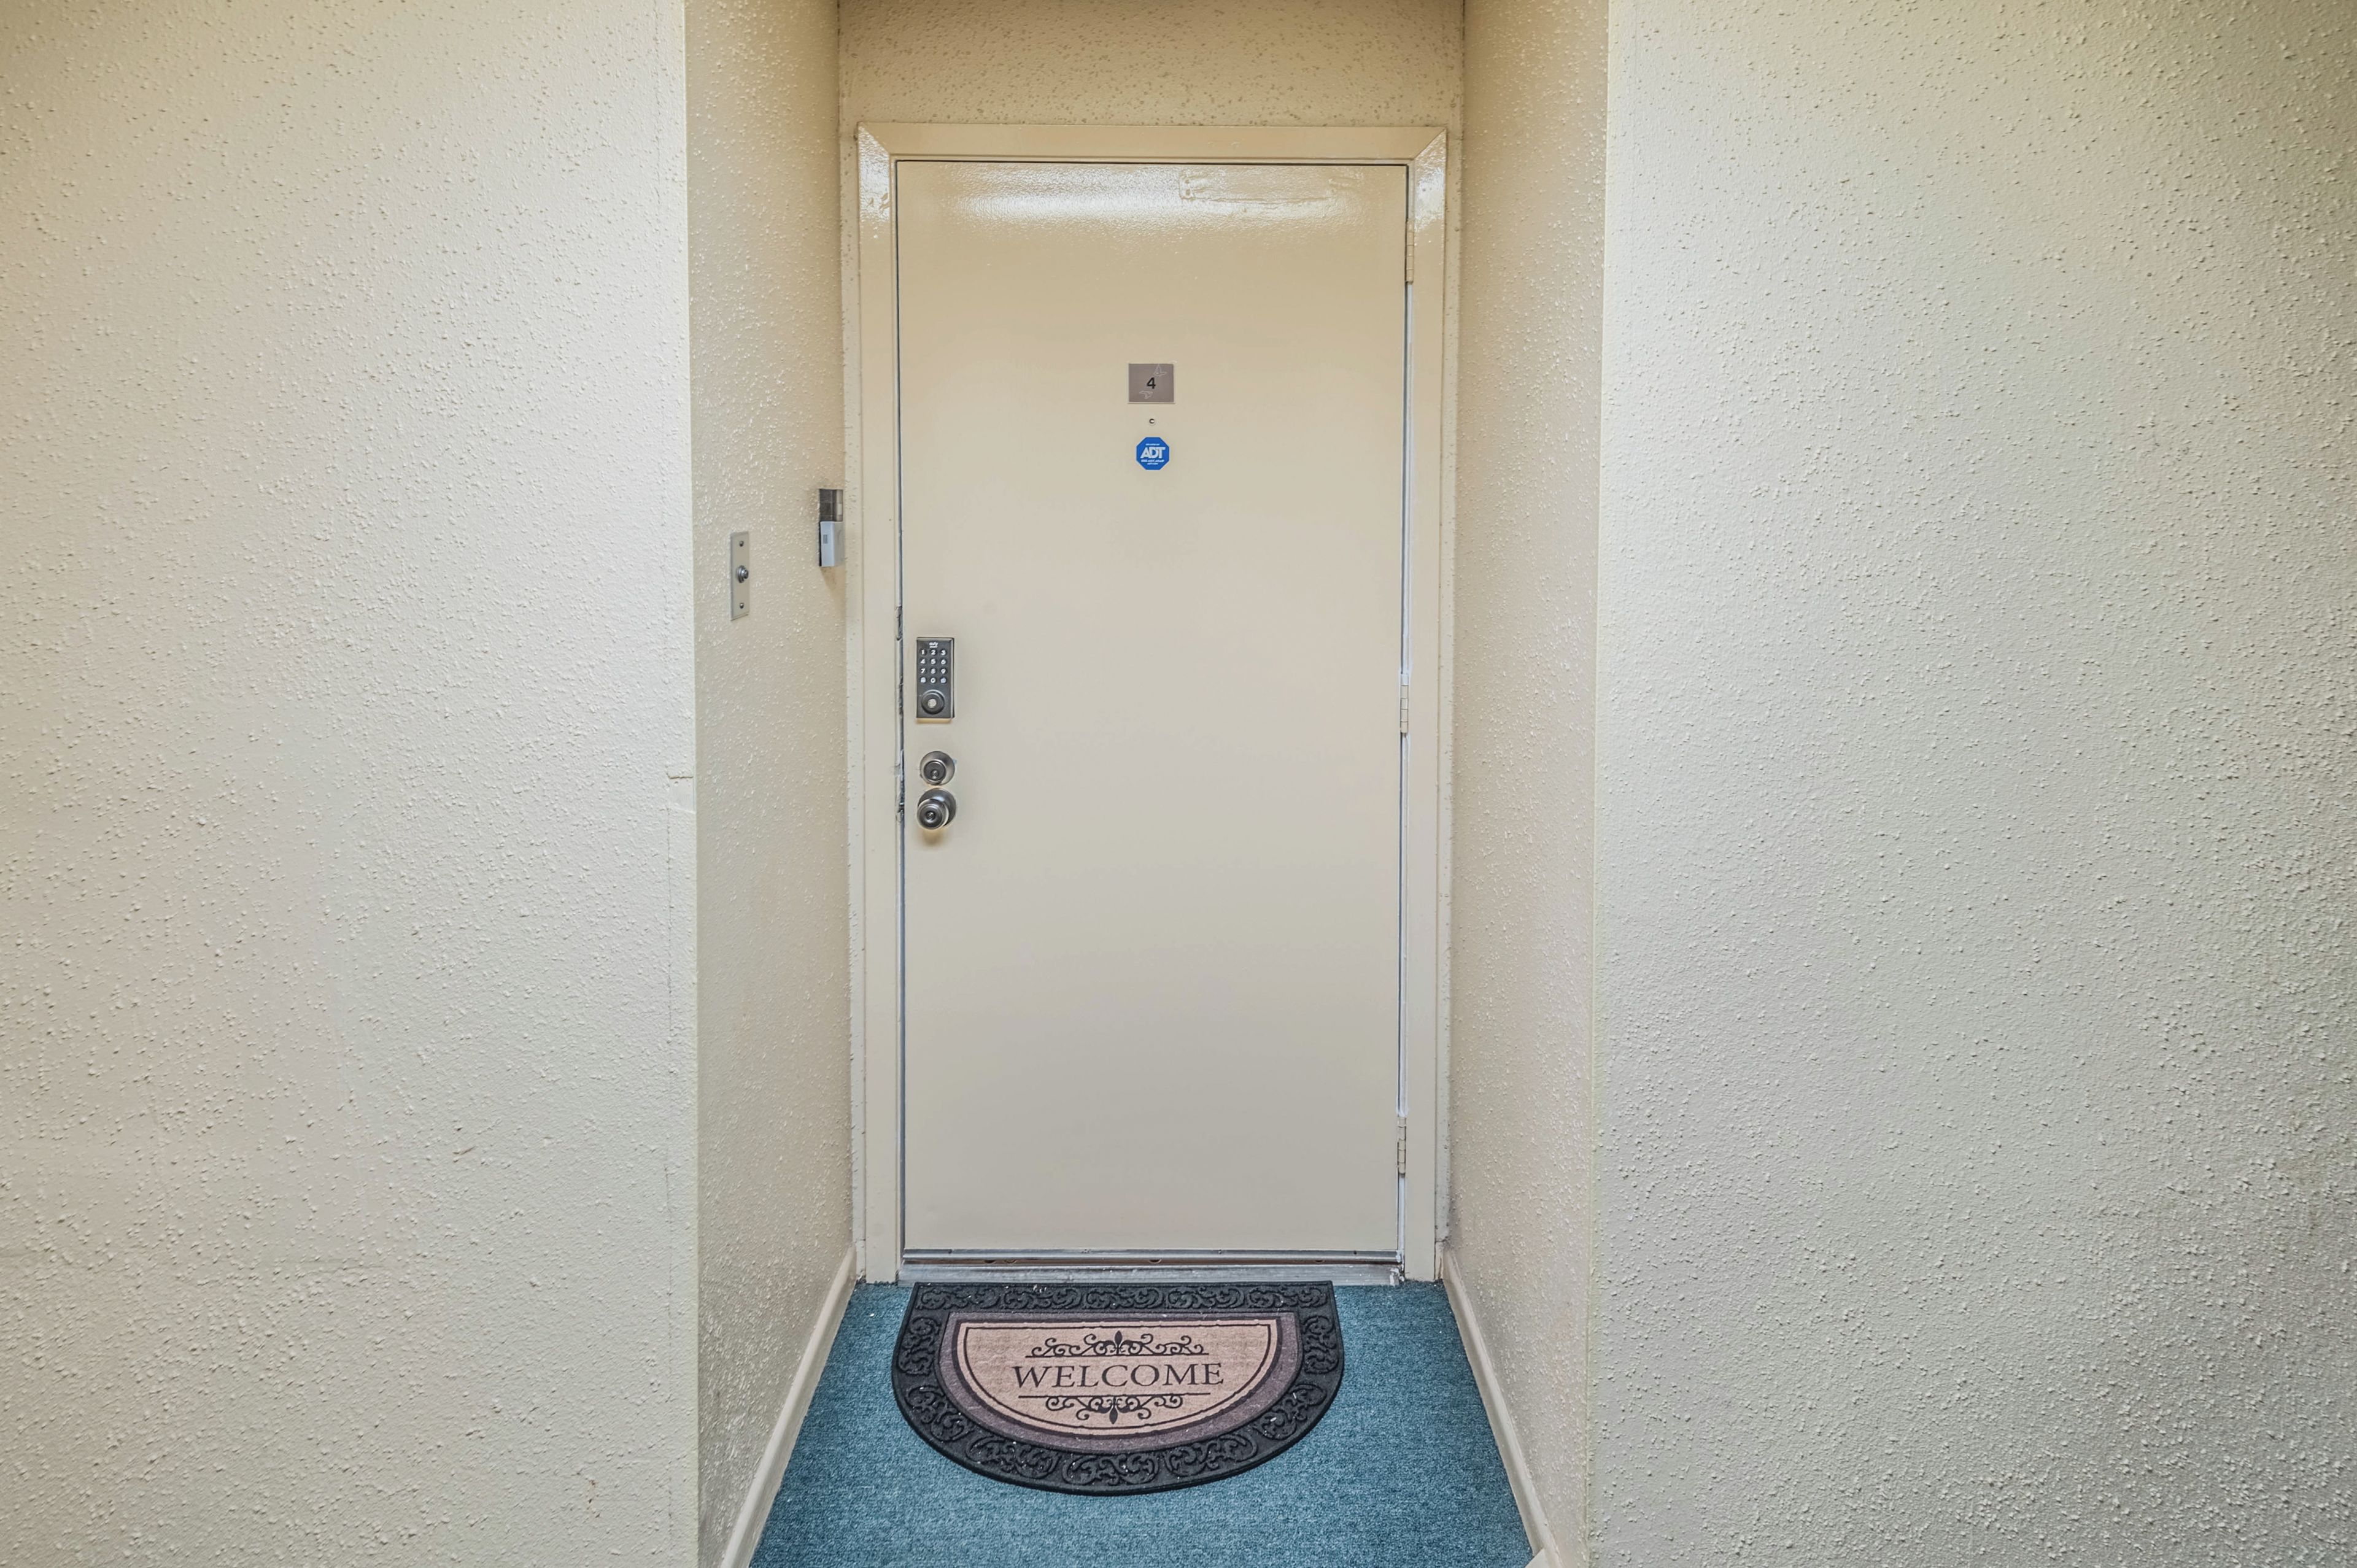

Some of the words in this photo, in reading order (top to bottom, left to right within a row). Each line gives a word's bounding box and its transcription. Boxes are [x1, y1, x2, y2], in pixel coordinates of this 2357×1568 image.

[1147, 377, 1156, 389] 4
[1140, 446, 1166, 458] ADT
[1012, 1362, 1224, 1388] WELCOME
